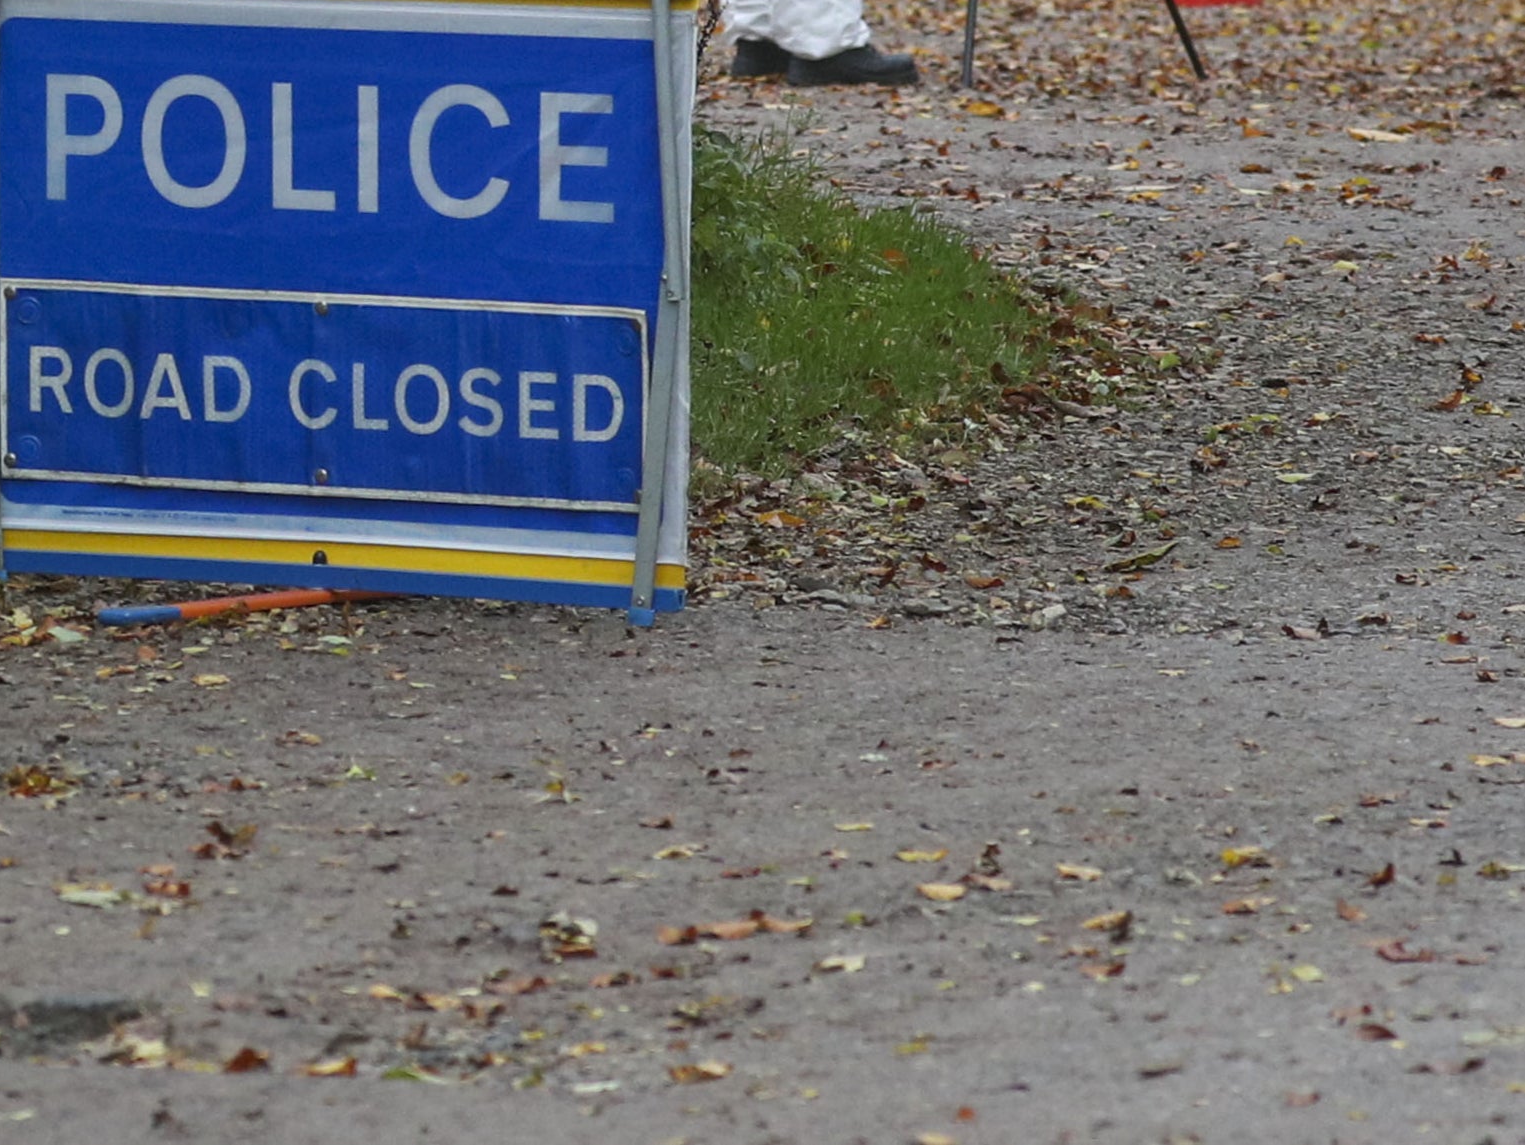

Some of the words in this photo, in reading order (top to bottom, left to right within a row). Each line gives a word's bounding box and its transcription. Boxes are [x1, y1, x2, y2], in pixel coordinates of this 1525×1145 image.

[46, 73, 615, 223] POLICE
[29, 346, 251, 423] ROAD
[288, 359, 625, 443] CLOSED
